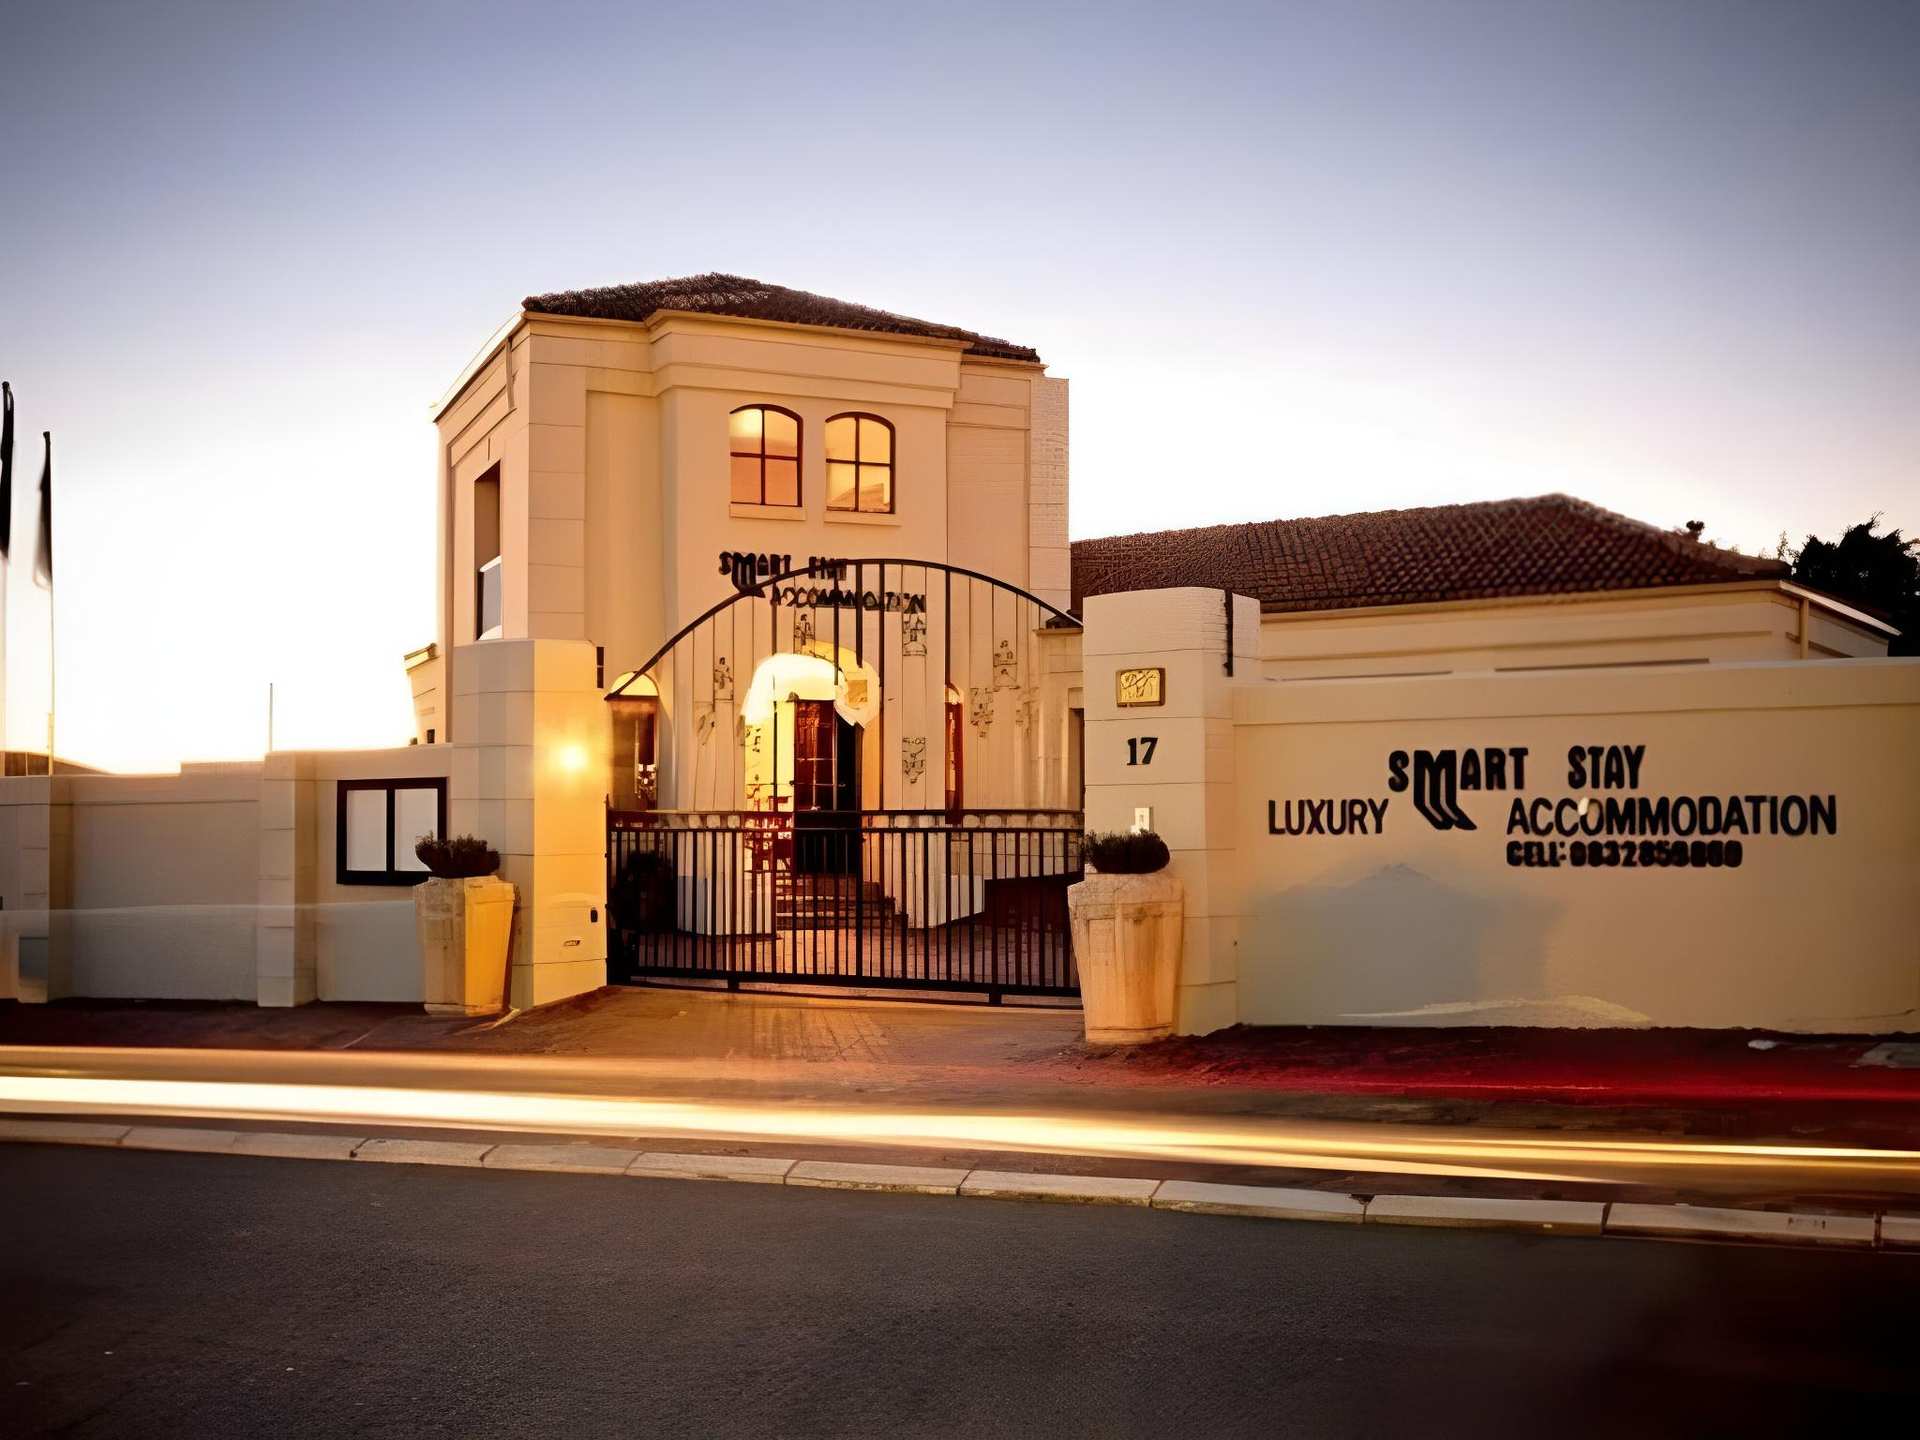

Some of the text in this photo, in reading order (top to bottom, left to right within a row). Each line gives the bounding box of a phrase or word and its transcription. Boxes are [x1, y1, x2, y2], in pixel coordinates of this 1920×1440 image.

[1126, 736, 1159, 766] 17
[1388, 744, 1646, 831] SMART STAY
[1268, 794, 1837, 837] LUXURY ACCOMMODATION
